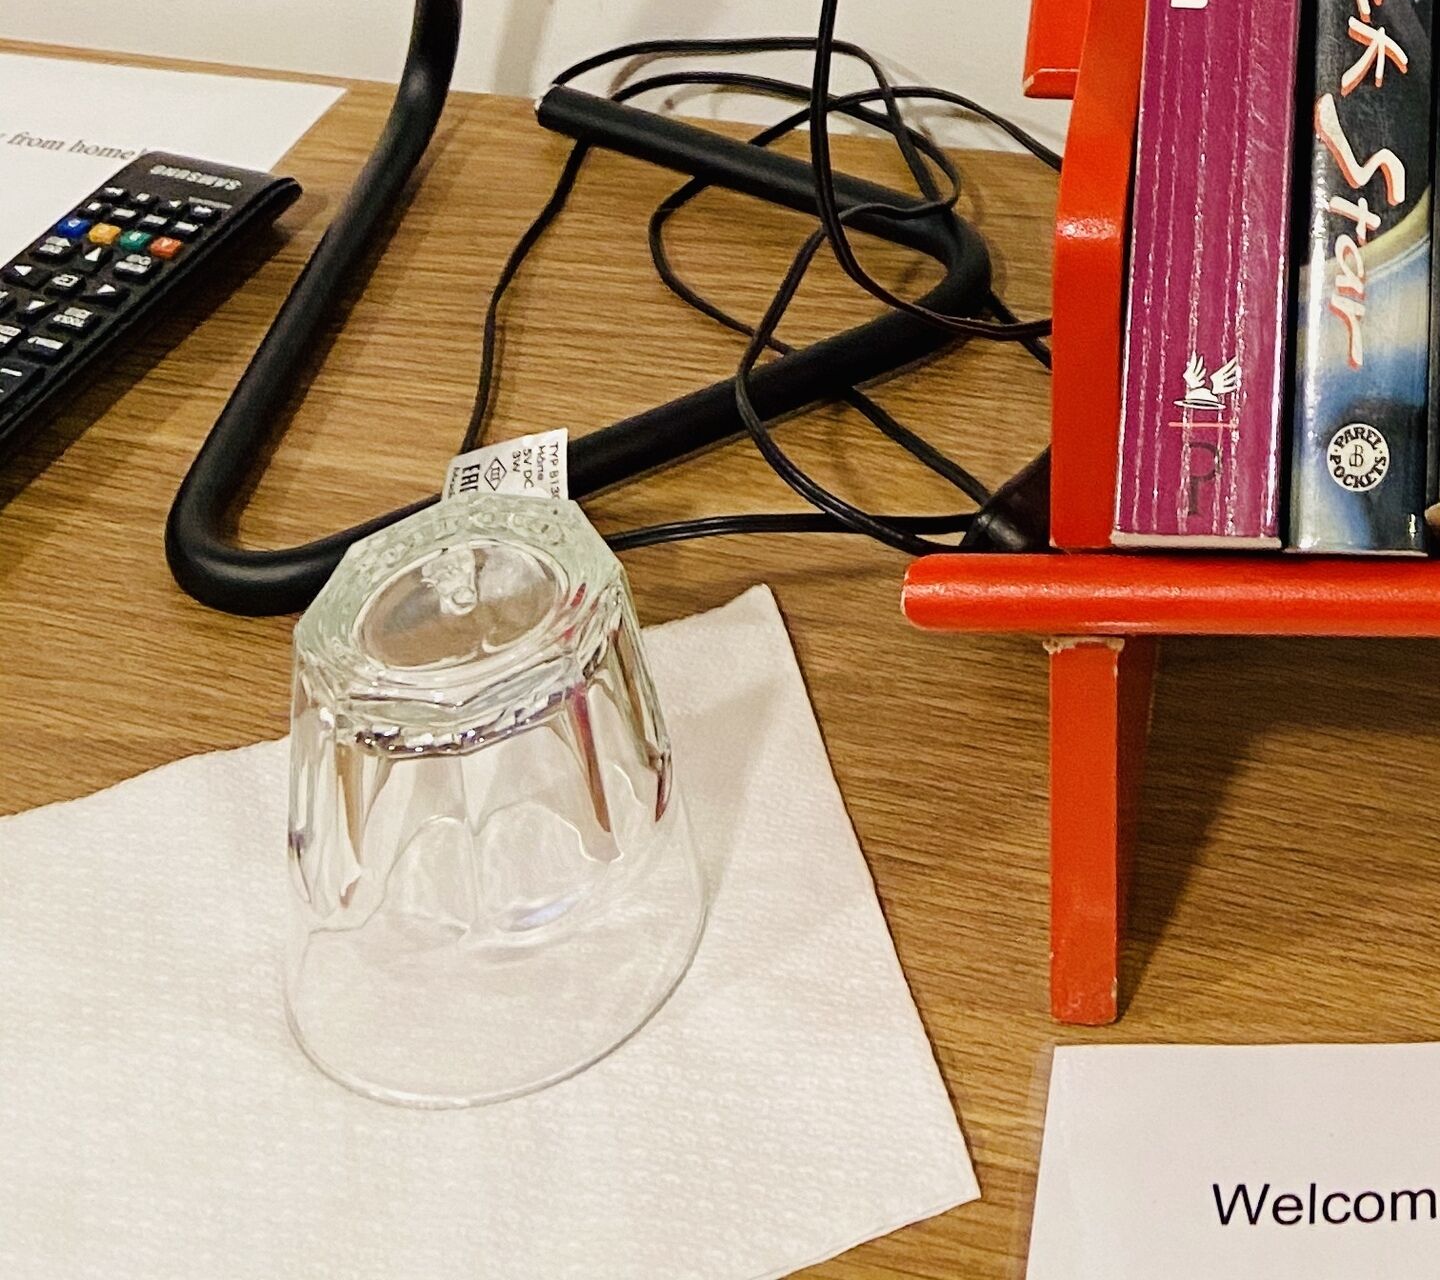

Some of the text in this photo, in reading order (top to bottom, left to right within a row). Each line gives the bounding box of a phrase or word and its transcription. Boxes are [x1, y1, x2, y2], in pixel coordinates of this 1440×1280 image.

[7, 131, 66, 152] from
[1334, 426, 1382, 450] PAREL
[549, 441, 559, 466] TYP
[523, 469, 534, 489] DC
[1329, 454, 1387, 489] POCKETS
